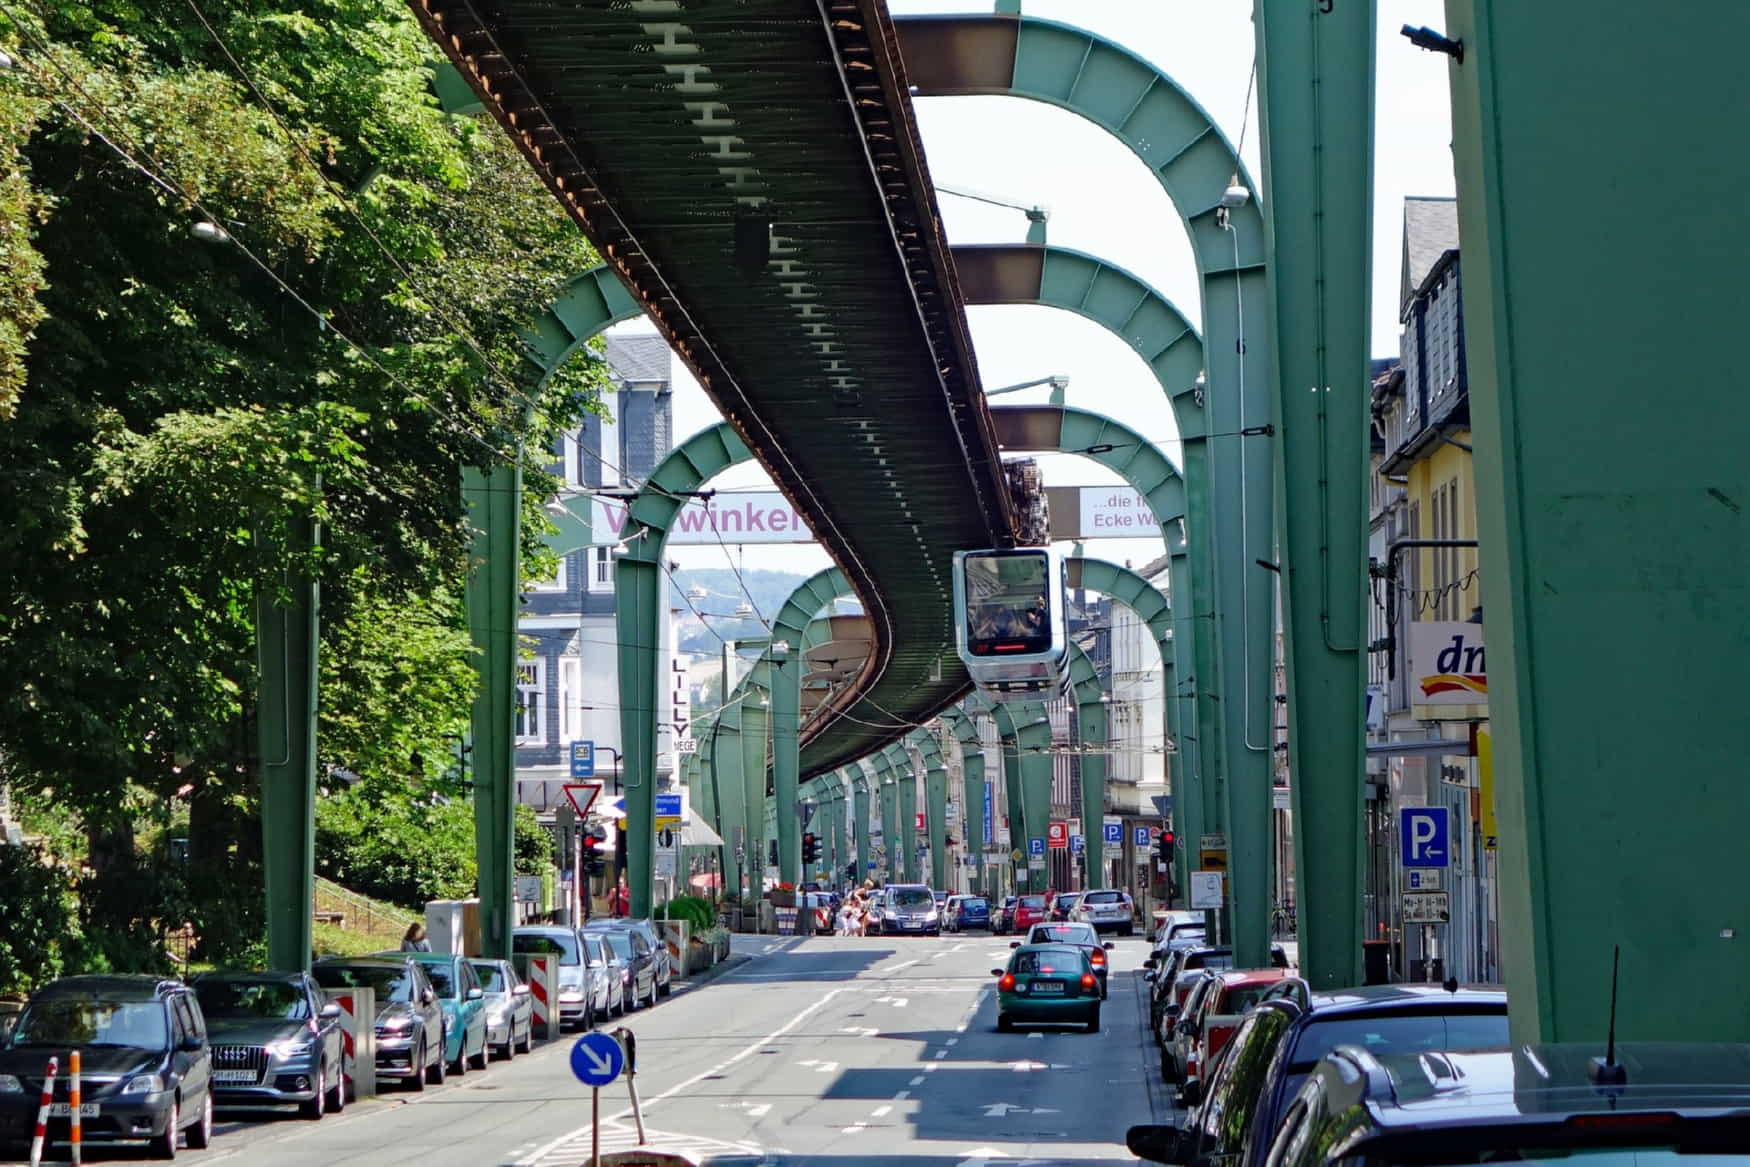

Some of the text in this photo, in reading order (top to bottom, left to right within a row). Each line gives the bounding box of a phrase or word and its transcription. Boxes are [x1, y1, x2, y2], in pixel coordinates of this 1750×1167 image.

[1094, 513, 1132, 527] Ecke
[672, 658, 689, 738] LILLY
[1411, 816, 1436, 860] P
